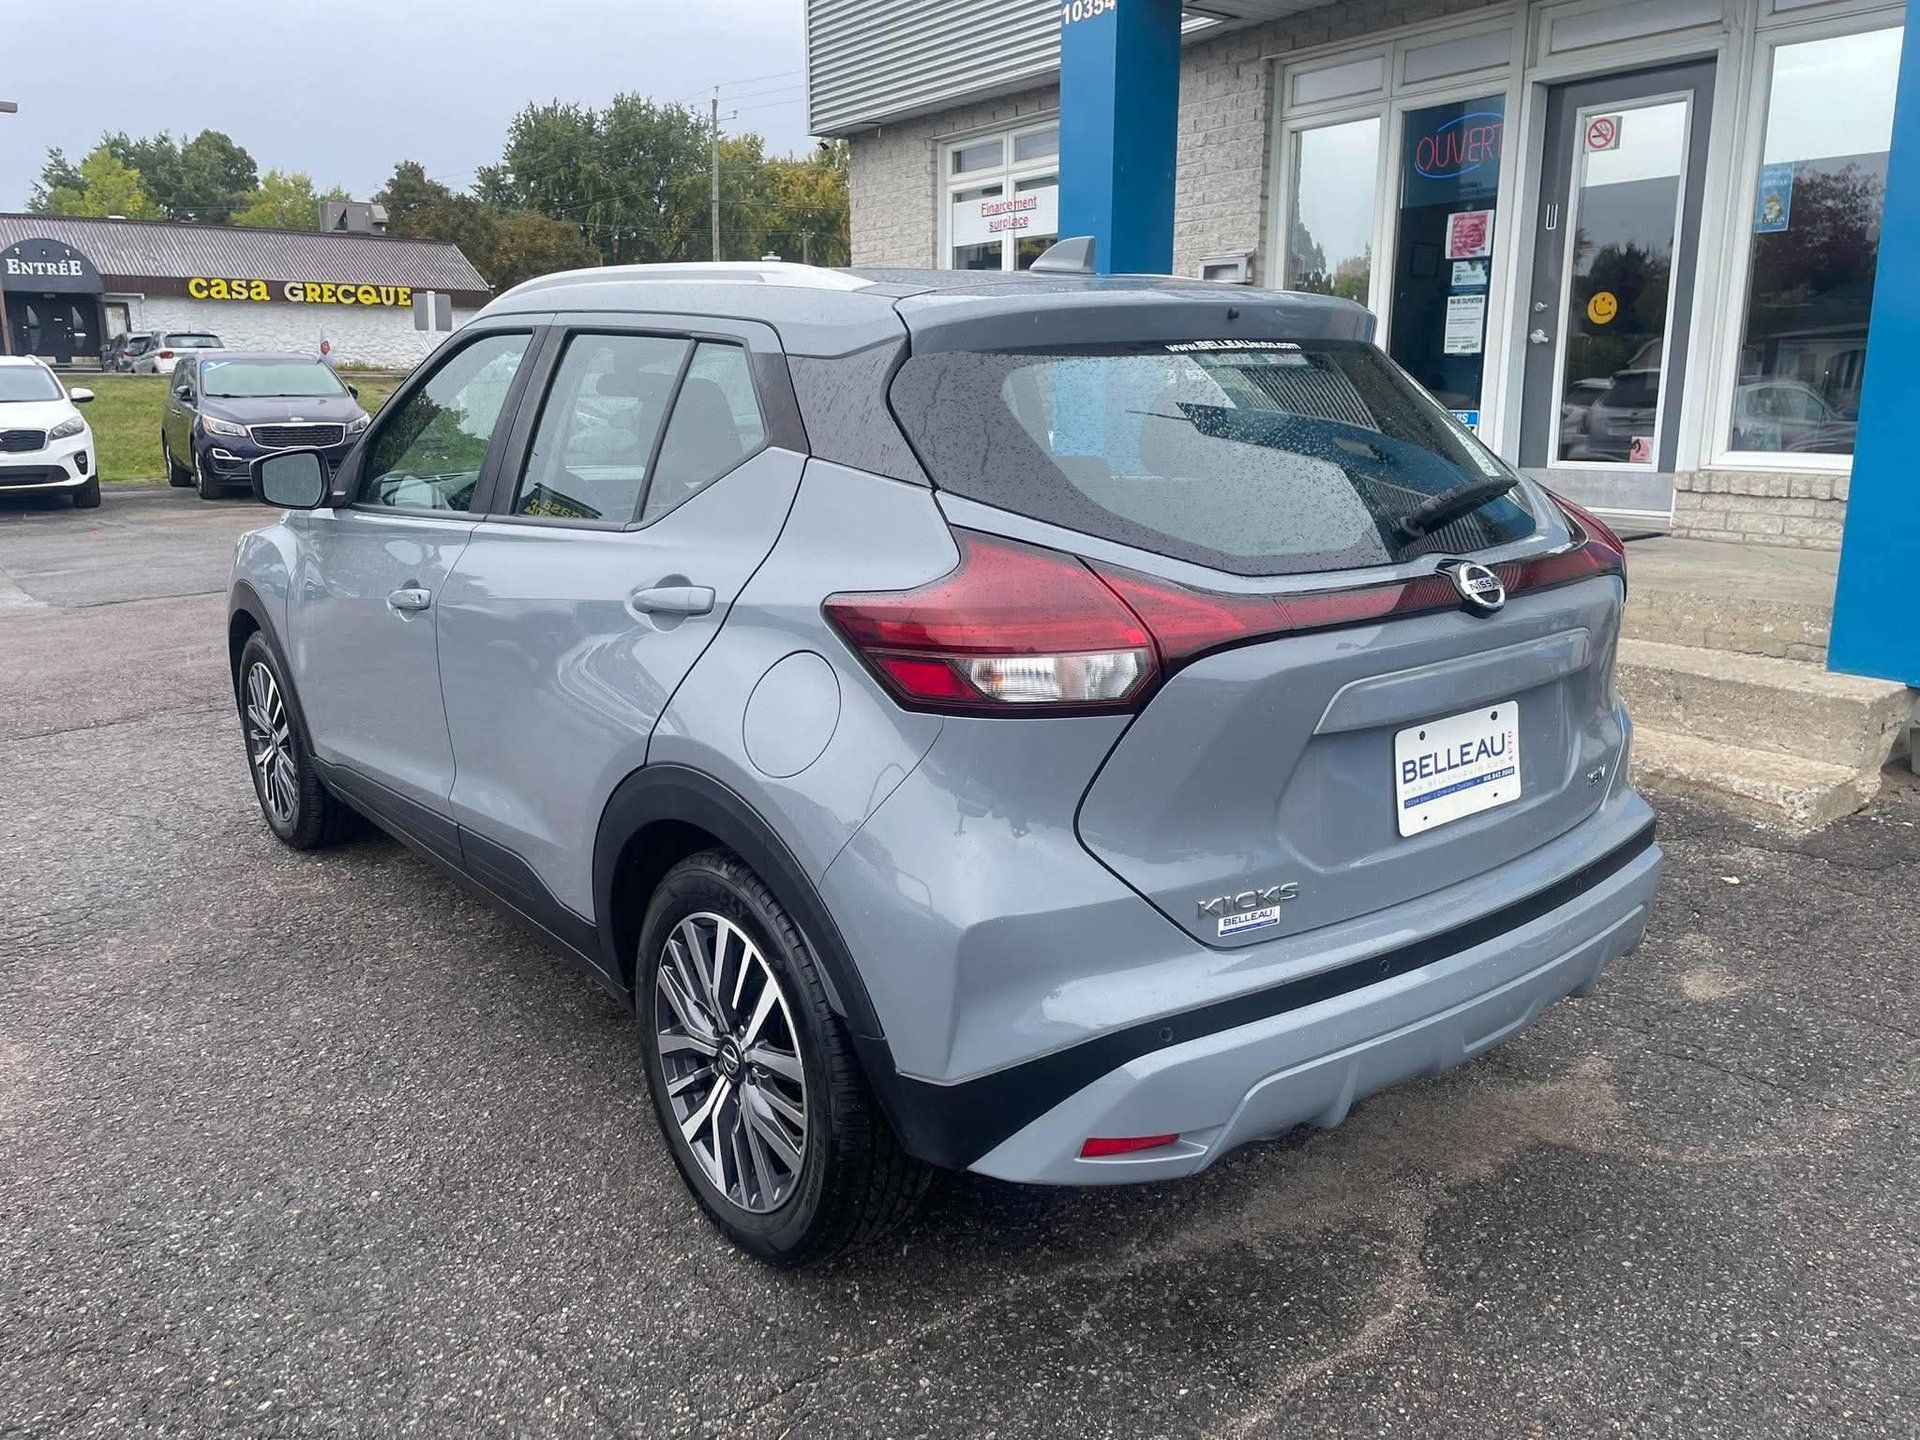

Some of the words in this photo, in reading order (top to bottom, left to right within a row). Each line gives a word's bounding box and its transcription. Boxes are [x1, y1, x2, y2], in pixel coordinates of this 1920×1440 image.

[1063, 0, 1116, 24] 10354
[1416, 123, 1504, 170] OUVERT
[284, 282, 411, 306] GRECQUE
[1402, 732, 1506, 785] BELLEAU
[1198, 882, 1298, 919] KICKS
[1223, 908, 1273, 927] BELLEAU
